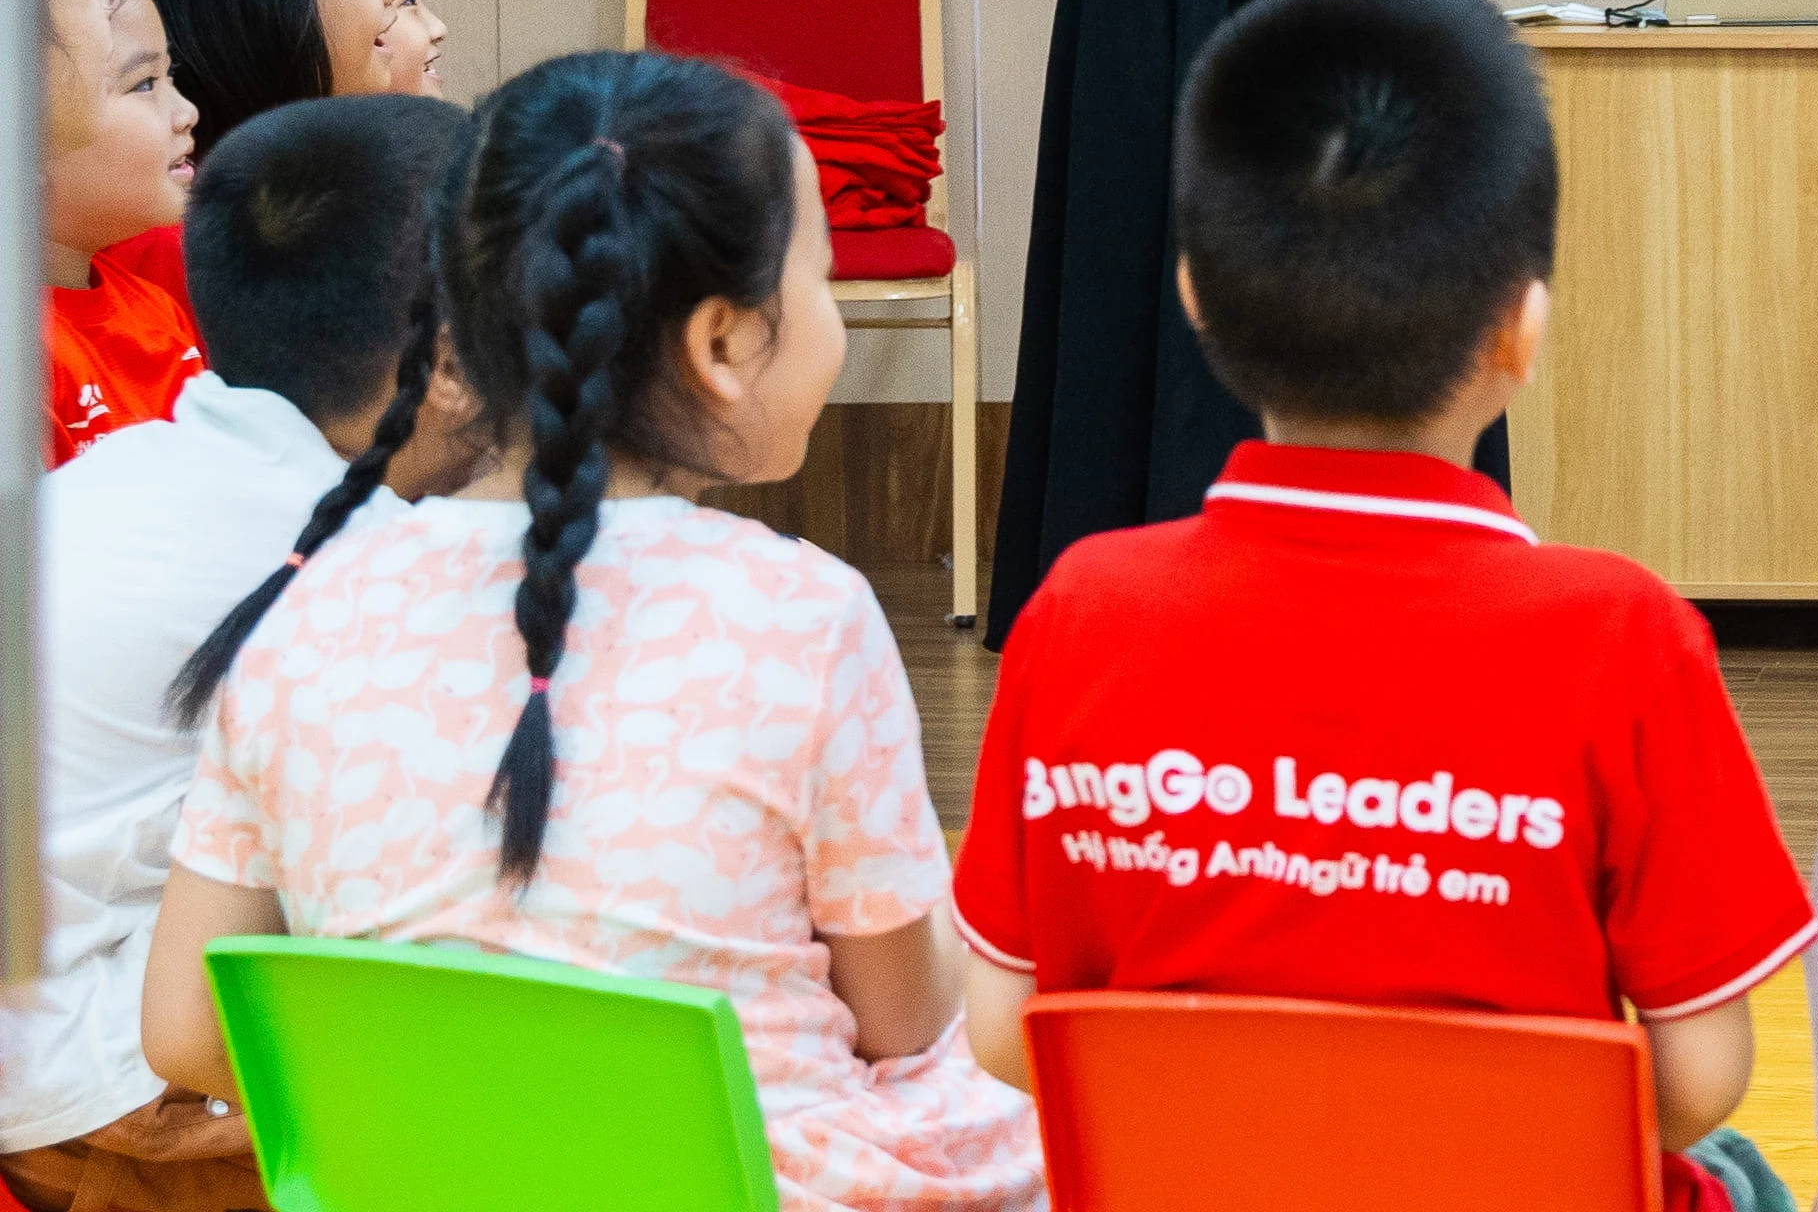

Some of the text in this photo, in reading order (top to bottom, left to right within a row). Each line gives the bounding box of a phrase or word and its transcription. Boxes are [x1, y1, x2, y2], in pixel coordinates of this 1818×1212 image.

[1273, 756, 1565, 848] Leaders
[1374, 853, 1431, 897] trẻ
[1438, 869, 1510, 906] em
